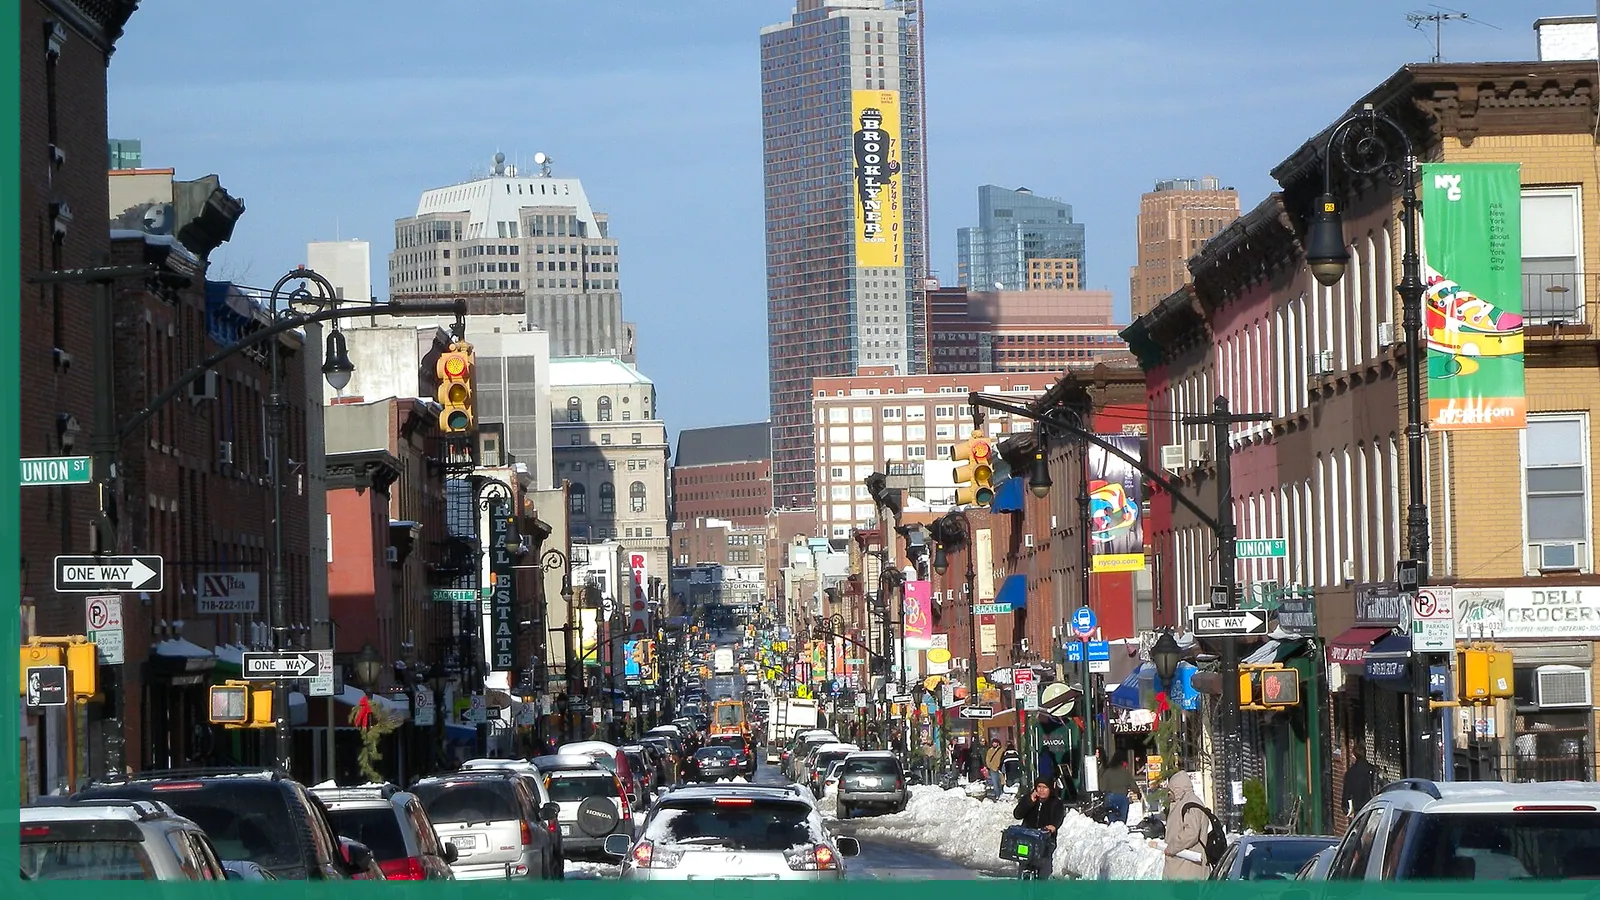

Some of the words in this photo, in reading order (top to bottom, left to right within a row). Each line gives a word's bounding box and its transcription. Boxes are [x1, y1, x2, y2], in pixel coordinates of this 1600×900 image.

[862, 119, 882, 233] BROOKLYNER
[23, 460, 68, 481] UNION
[74, 460, 85, 470] ST
[494, 504, 510, 564] REAL
[1240, 541, 1272, 556] UNION
[1098, 558, 1138, 567] nycgo.com
[67, 567, 95, 580] ONE
[101, 567, 130, 580] WAY
[433, 591, 466, 599] SACKETT
[1532, 590, 1582, 605] DELI
[976, 604, 1005, 613] SACKETT
[1507, 607, 1600, 622] GROCERY
[496, 575, 512, 667] ESTATE
[1201, 618, 1220, 628] ONE
[1224, 618, 1245, 627] WAY
[254, 660, 276, 670] ONE
[286, 660, 308, 670] WAY
[586, 809, 612, 820] HONDA
